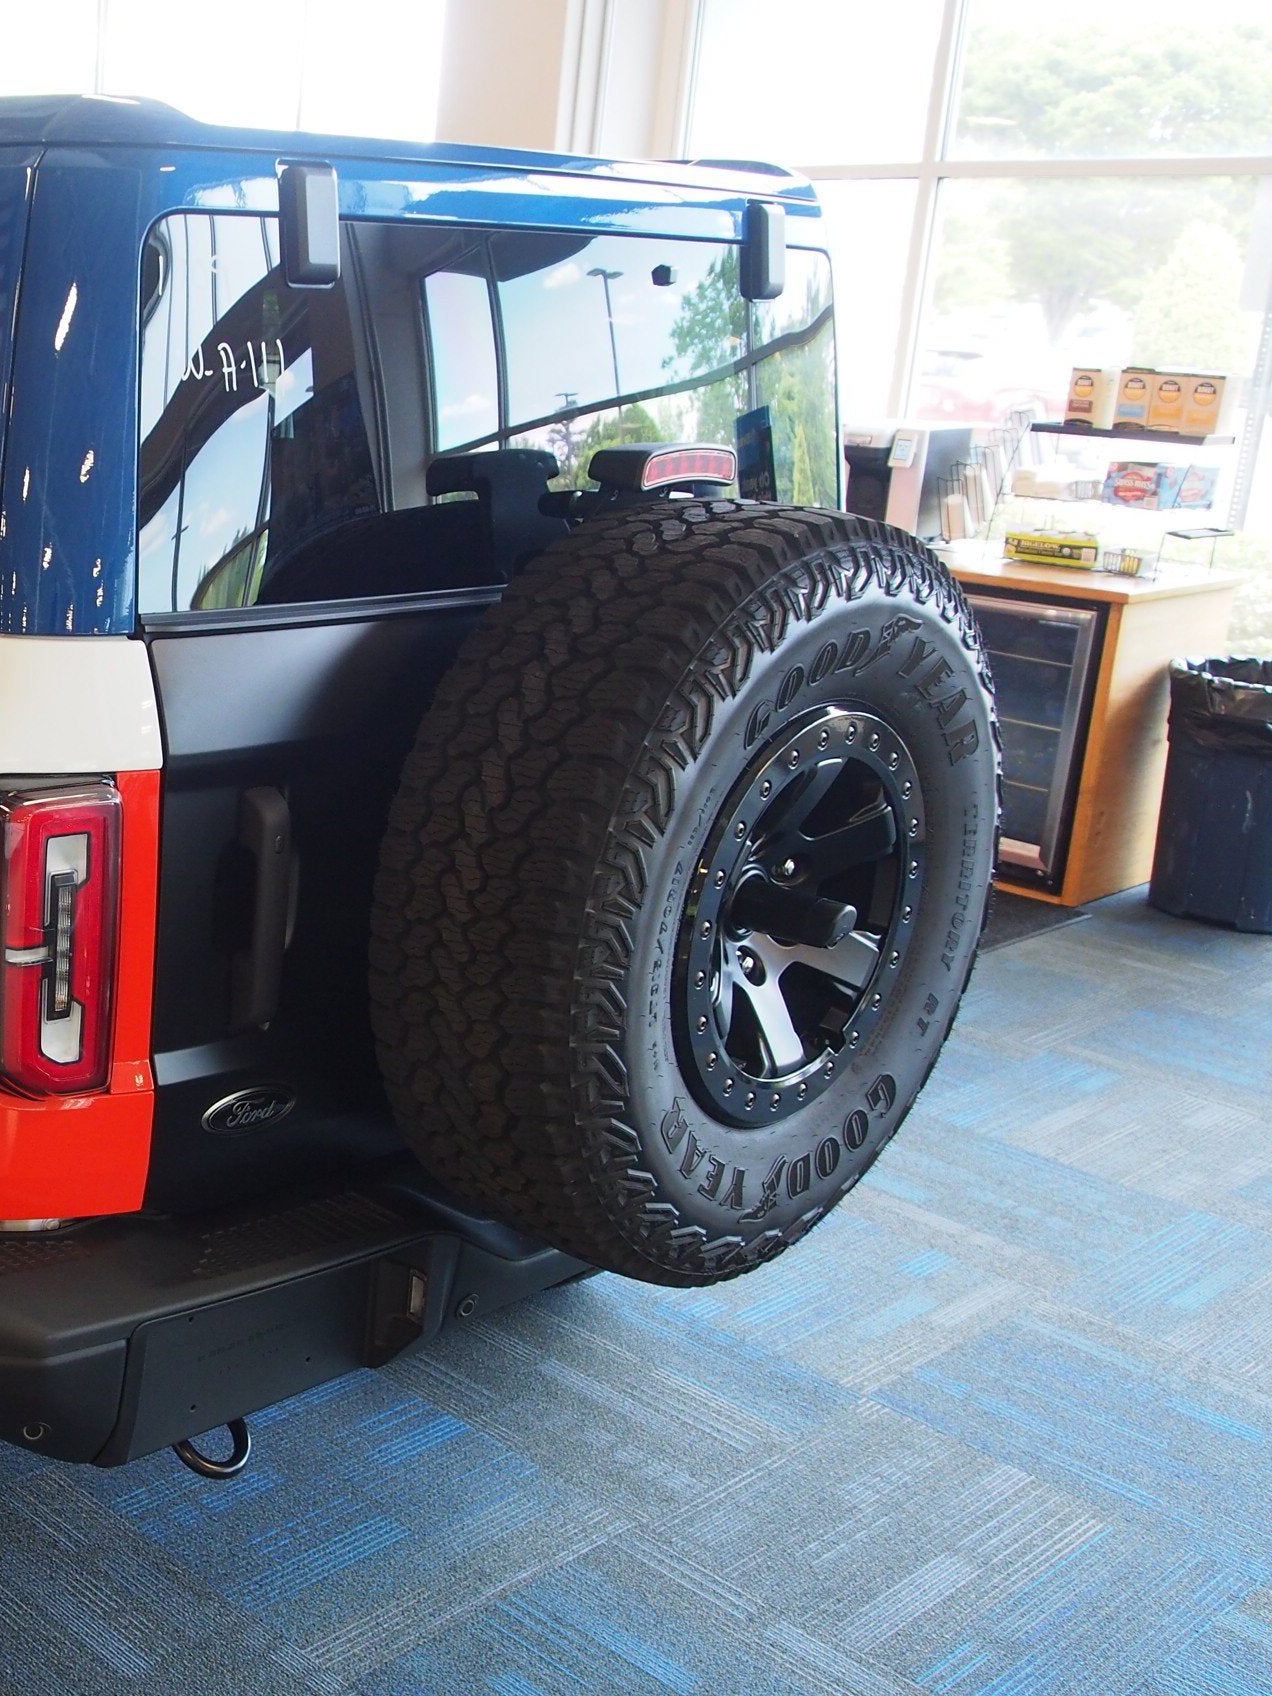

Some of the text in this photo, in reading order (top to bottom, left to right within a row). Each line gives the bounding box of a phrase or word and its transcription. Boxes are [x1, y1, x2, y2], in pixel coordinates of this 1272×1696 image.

[744, 613, 979, 766] GOODYEAR
[940, 802, 979, 973] TERRITORY
[225, 1097, 277, 1128] Ford
[660, 1073, 897, 1224] GOODYEAR
